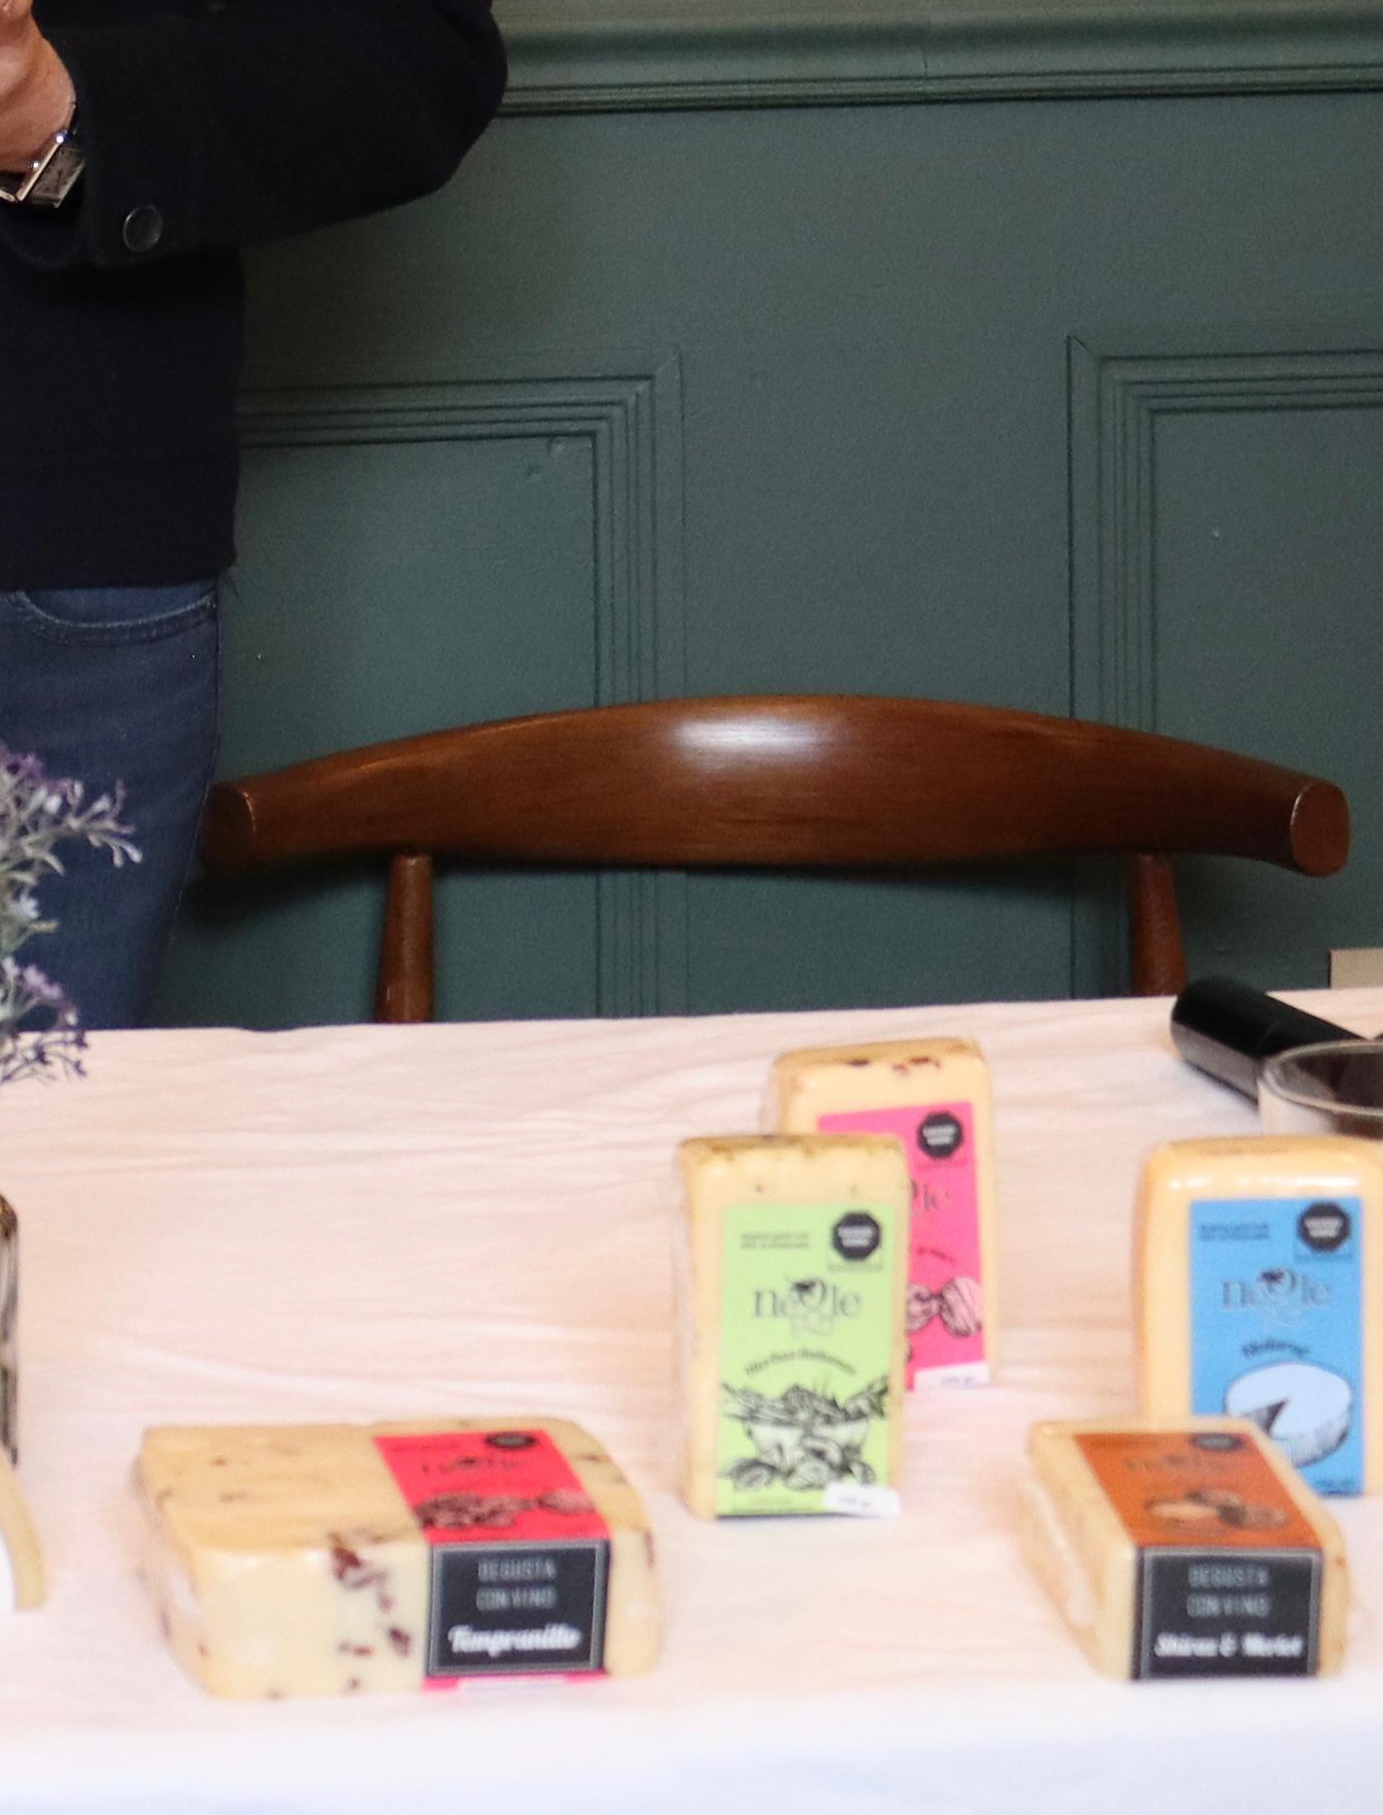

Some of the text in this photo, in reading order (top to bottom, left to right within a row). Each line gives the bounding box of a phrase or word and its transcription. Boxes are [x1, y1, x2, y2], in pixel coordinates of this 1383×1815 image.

[478, 1559, 557, 1582] DEGUSTA
[477, 1588, 510, 1611] CON
[447, 1623, 583, 1658] Tempranillo
